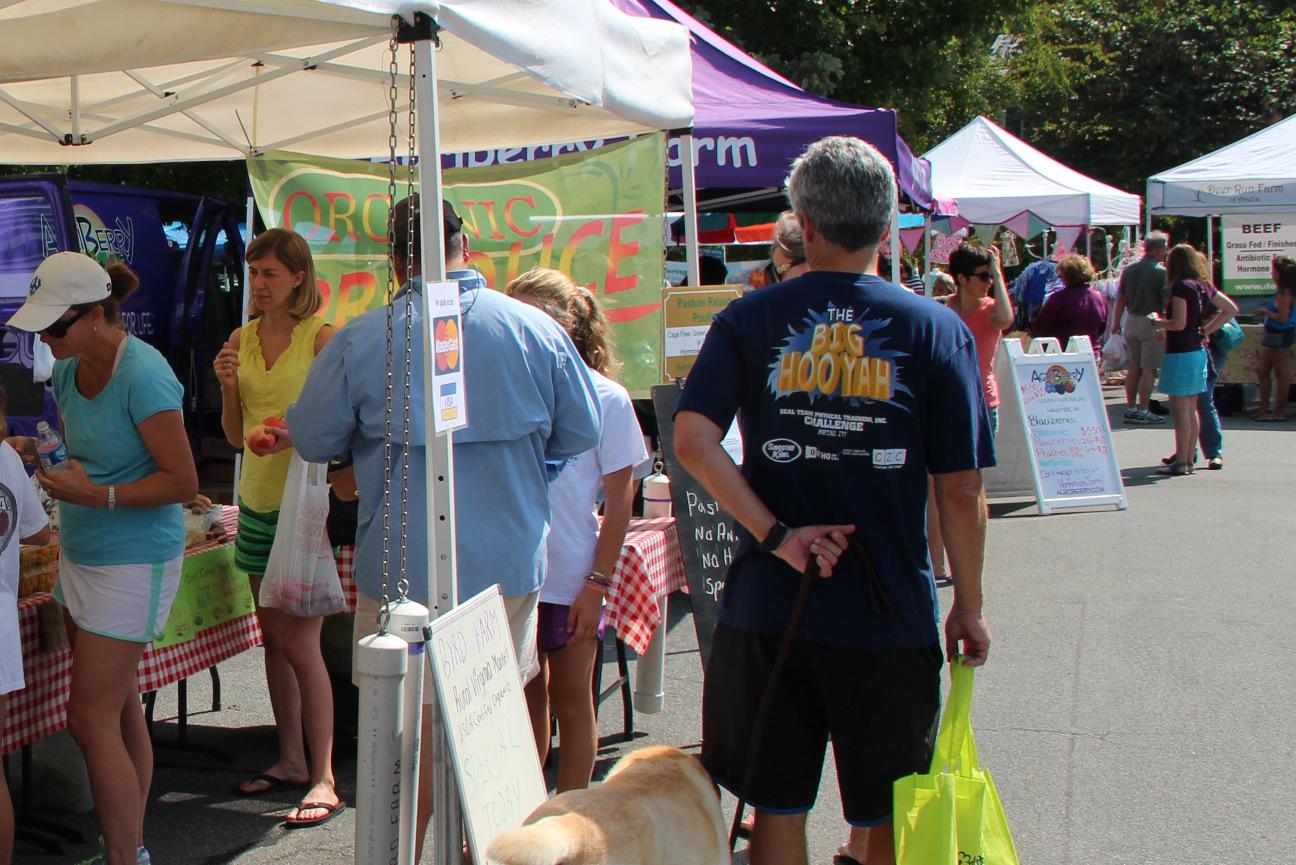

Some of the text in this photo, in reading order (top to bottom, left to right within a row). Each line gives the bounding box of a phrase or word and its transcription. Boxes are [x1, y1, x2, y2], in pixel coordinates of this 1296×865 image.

[668, 136, 757, 168] arm
[1208, 183, 1284, 194] Deer Run Farm
[1241, 223, 1282, 233] BEEF
[1226, 241, 1247, 249] Grass
[1249, 240, 1262, 248] Fed
[827, 309, 853, 321] THE
[435, 338, 459, 353] MasterCard
[810, 322, 864, 356] BIG
[777, 350, 891, 401] HOOYAH
[444, 398, 454, 408] VISA
[797, 409, 814, 417] TEAM
[814, 411, 842, 420] PHYSICAL
[804, 416, 864, 432] CHALLENGE
[473, 609, 502, 655] FARM
